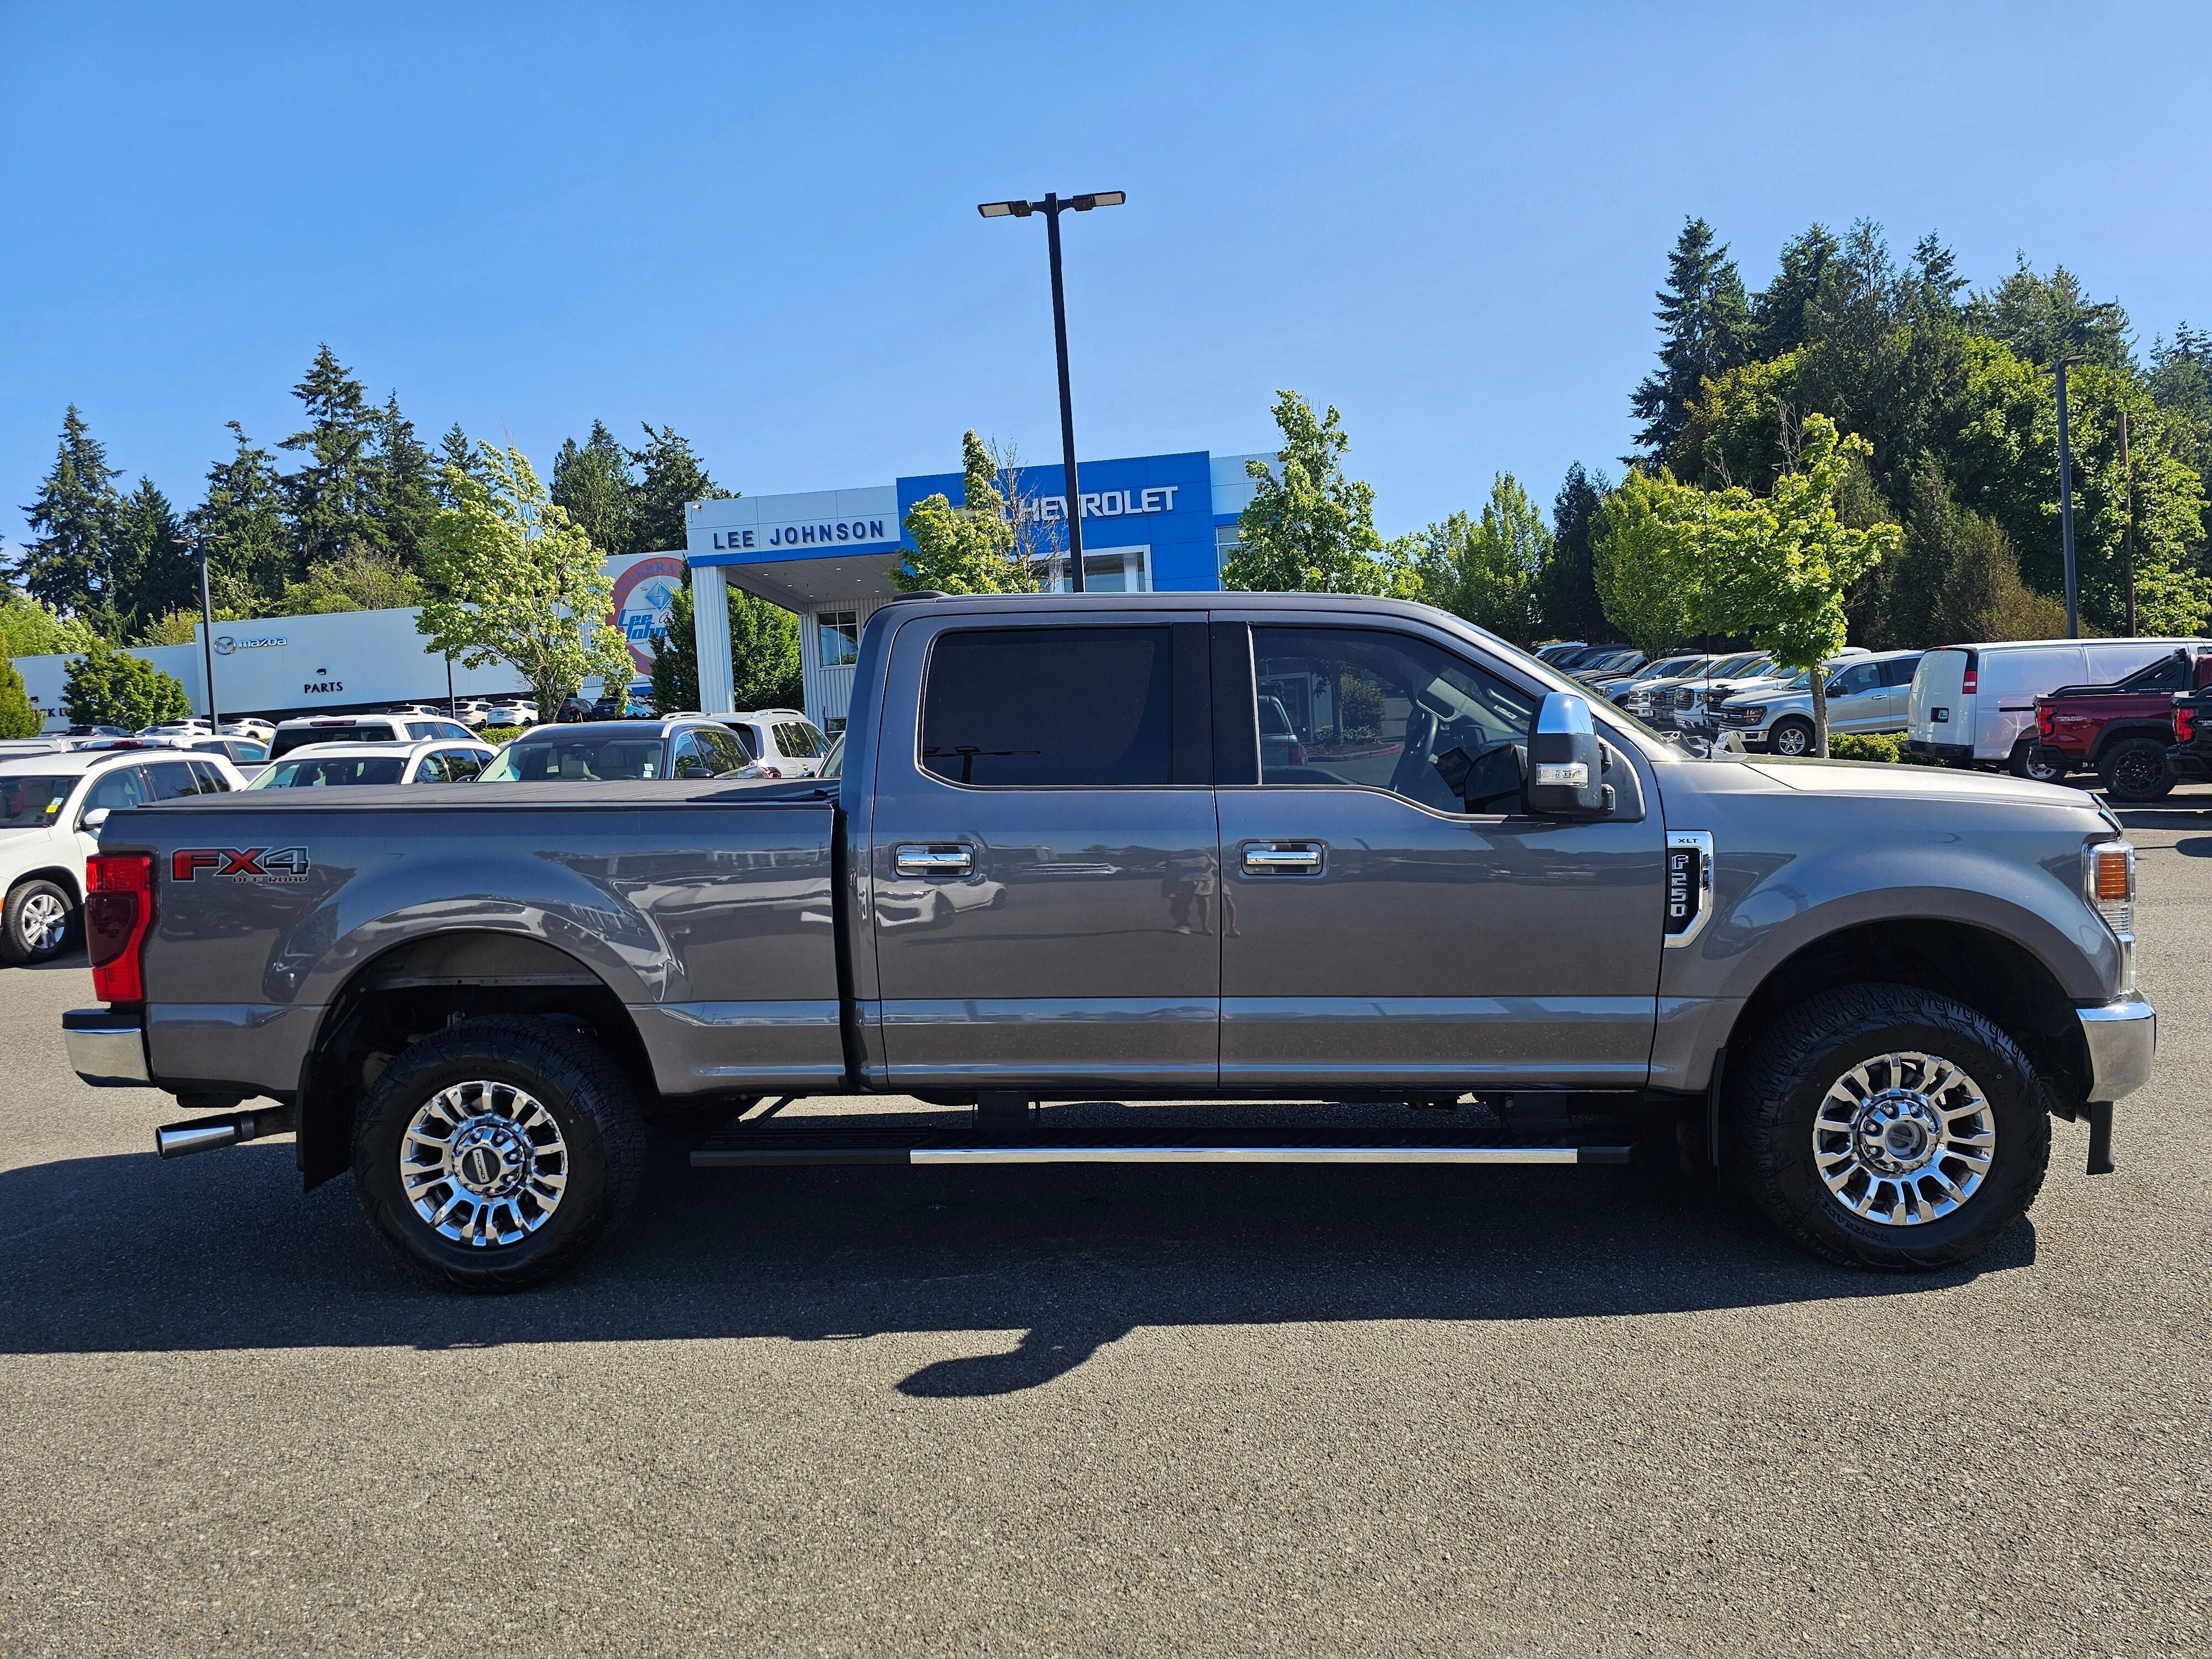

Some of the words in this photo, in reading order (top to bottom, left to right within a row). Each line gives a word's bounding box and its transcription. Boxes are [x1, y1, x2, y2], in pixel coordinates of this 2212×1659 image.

[713, 530, 755, 550] LEE
[769, 520, 884, 546] JOHNSON
[617, 609, 655, 627] Lee
[238, 637, 288, 649] mazda
[304, 681, 343, 693] PARTS
[171, 846, 311, 883] FX4
[476, 1152, 486, 1180] FORD
[1822, 1200, 1892, 1243] RENEGADE
